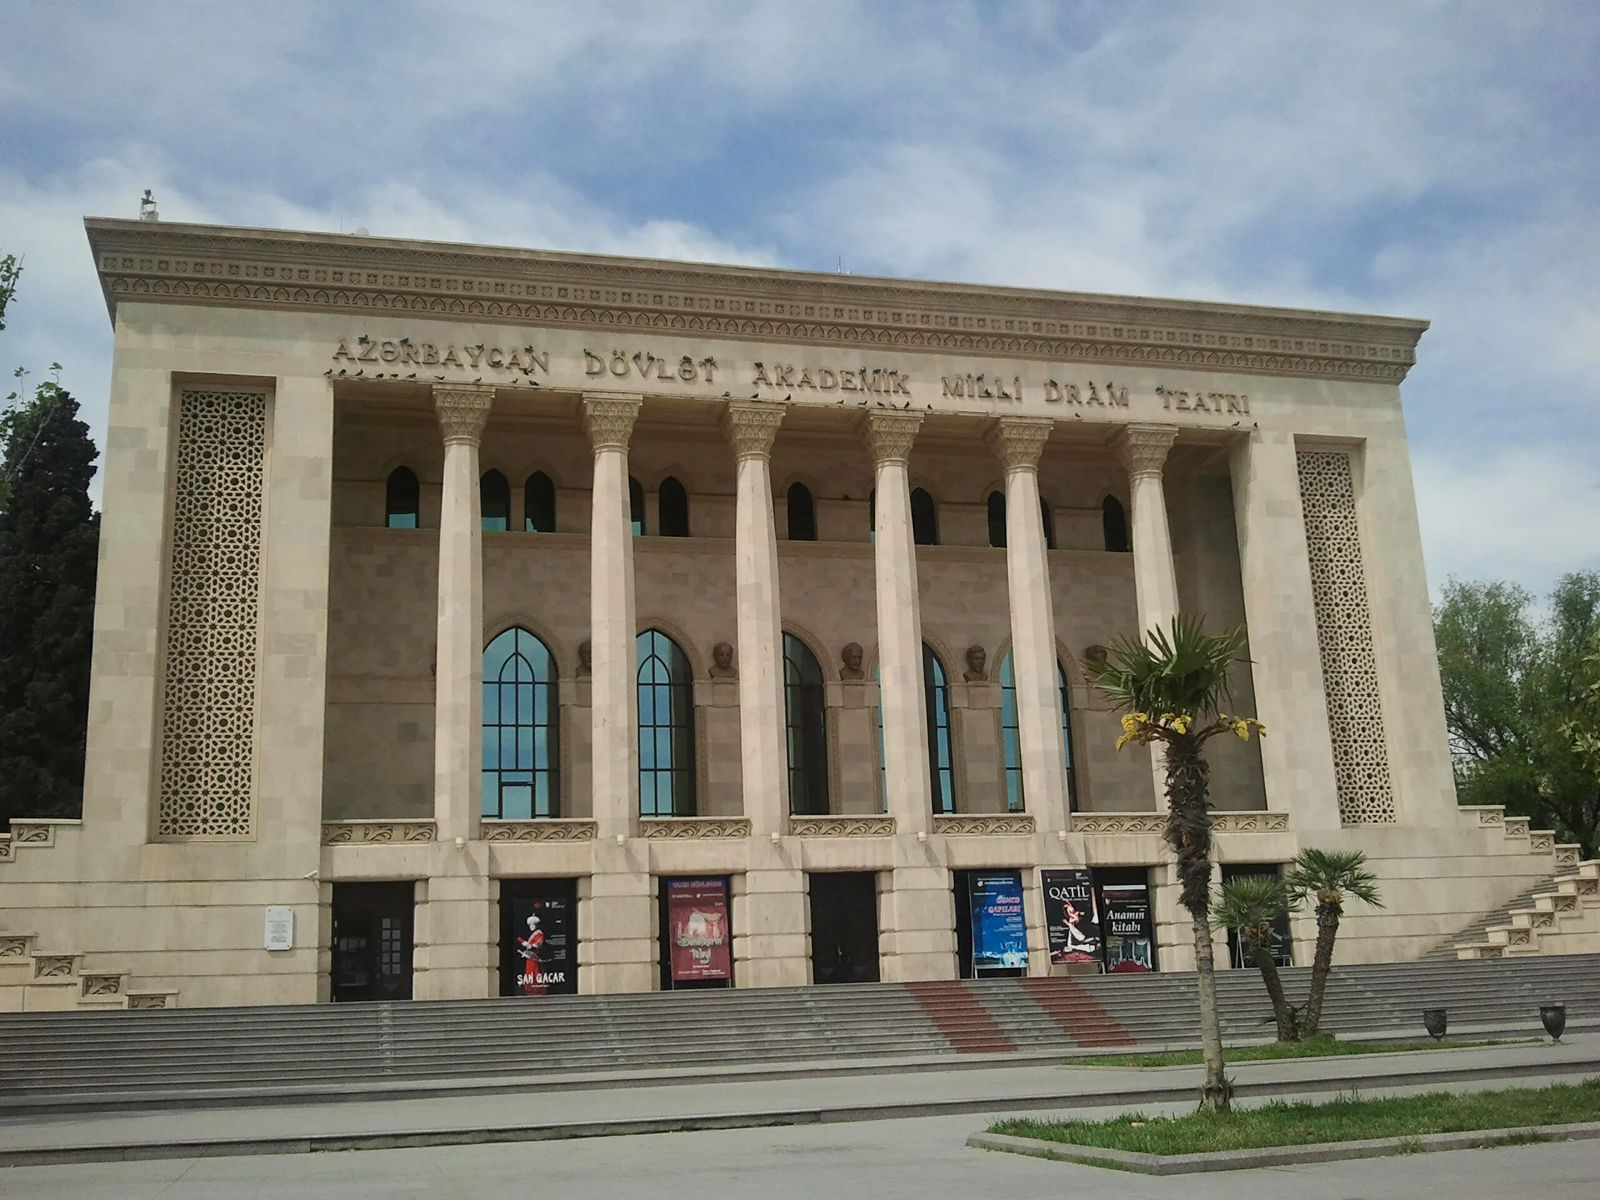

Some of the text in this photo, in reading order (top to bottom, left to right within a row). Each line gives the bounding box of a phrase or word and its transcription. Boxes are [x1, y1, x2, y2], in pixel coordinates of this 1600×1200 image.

[332, 339, 1250, 414] AZƏRBAYCAN DÖVLƏT AKADEMİK MİLLİ DRAM TEATRI
[1048, 885, 1090, 900] QATİL
[1106, 910, 1145, 920] Anamın
[1111, 921, 1141, 932] kitabı
